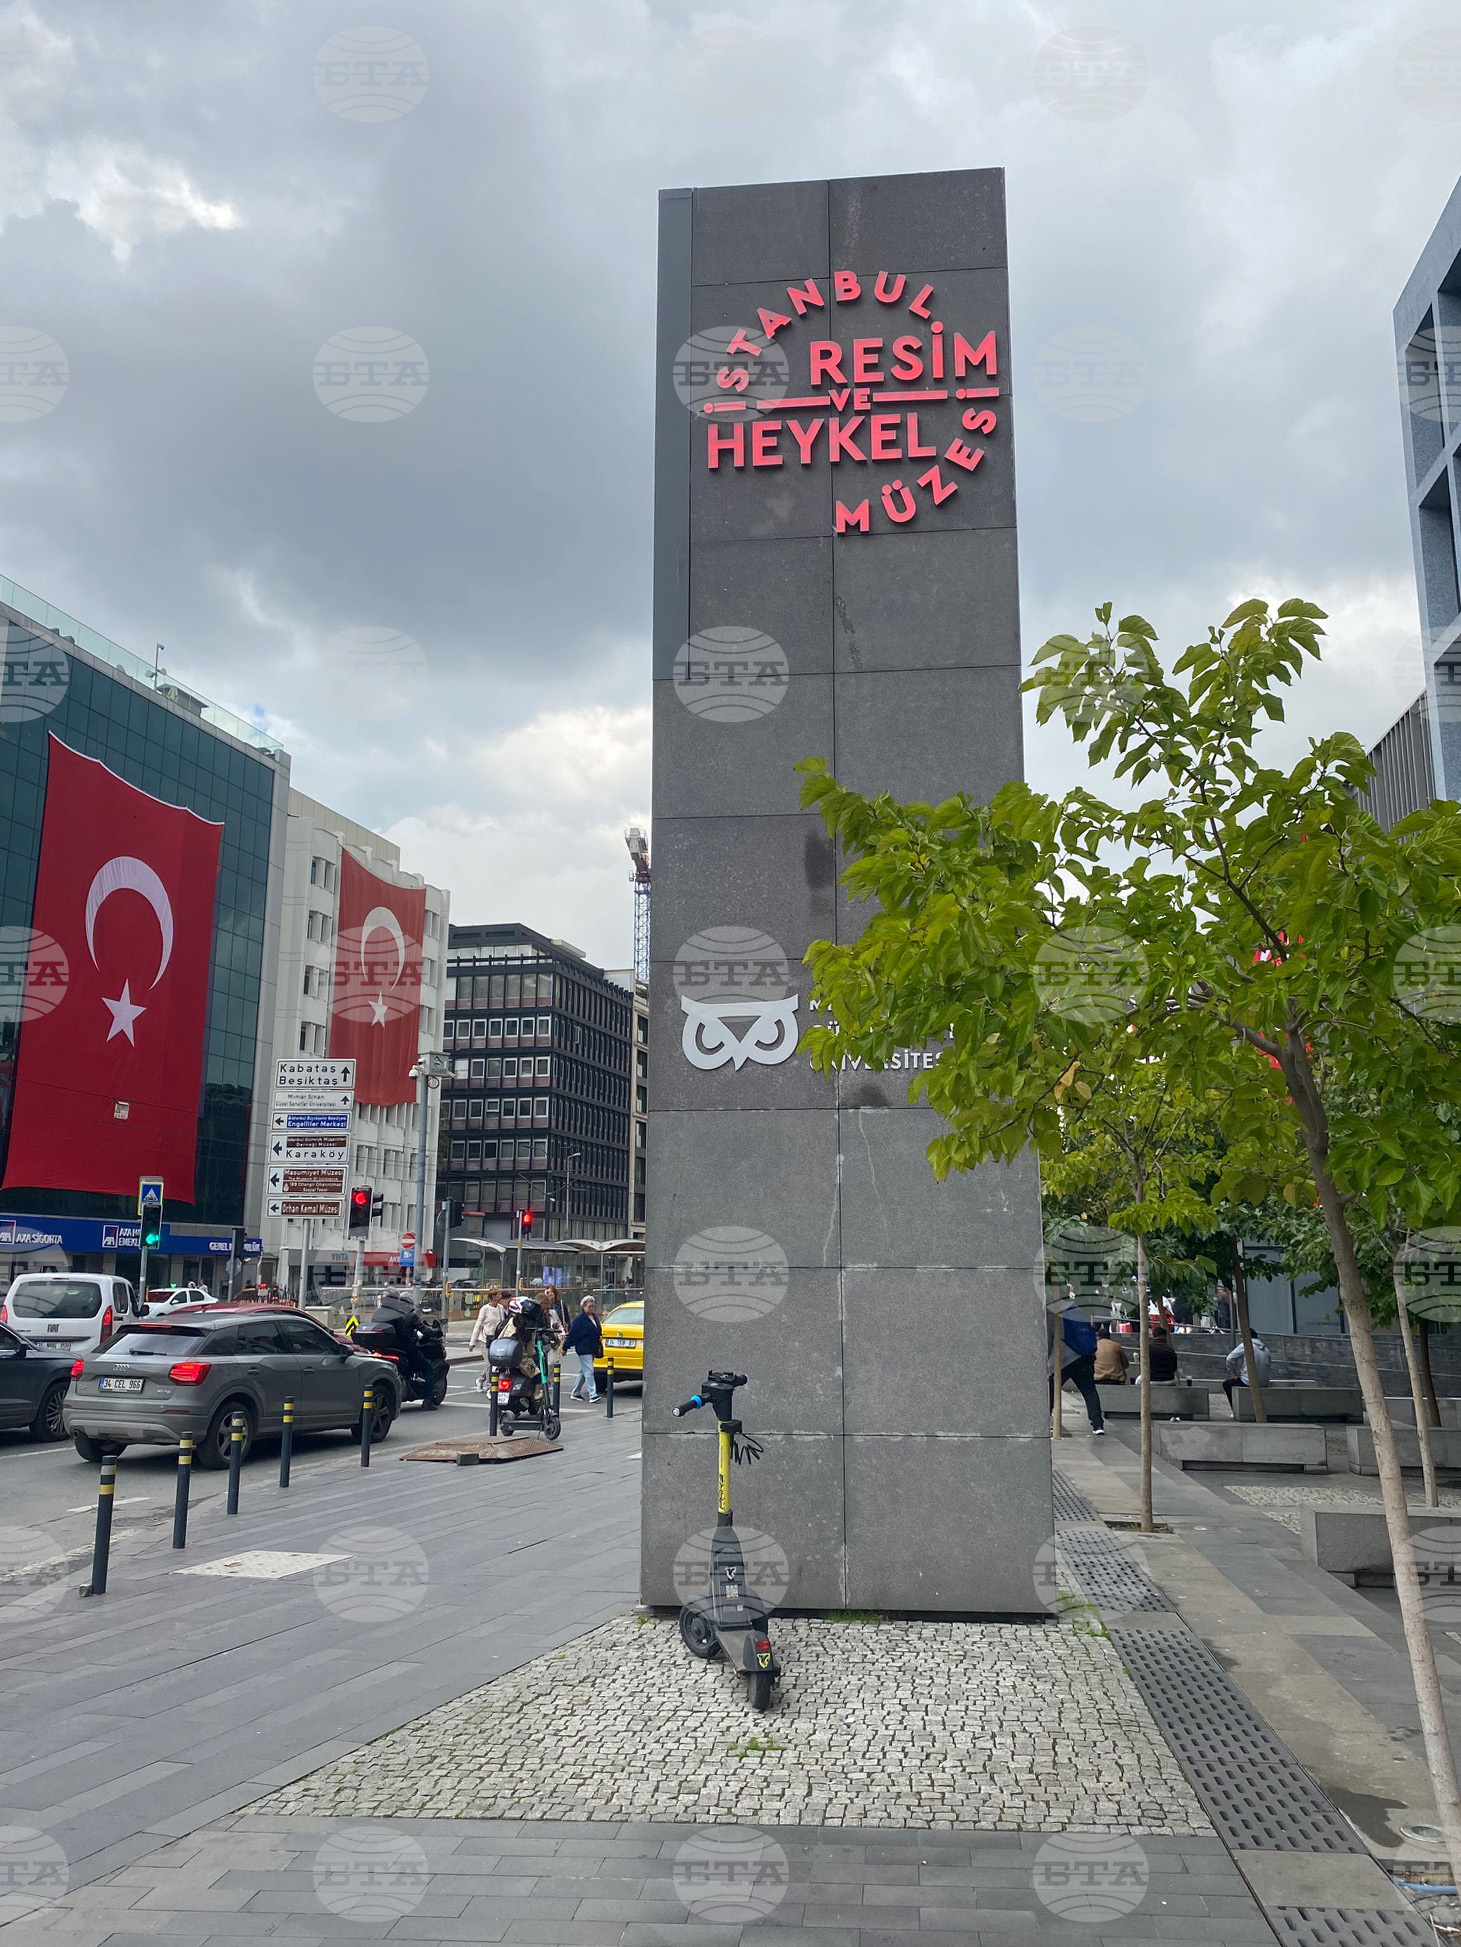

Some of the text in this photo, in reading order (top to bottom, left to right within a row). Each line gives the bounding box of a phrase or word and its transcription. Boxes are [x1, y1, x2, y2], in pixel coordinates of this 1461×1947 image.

[703, 270, 934, 414] İSTANBUL
[810, 320, 998, 387] RESİM
[828, 387, 872, 412] VE
[707, 411, 938, 471] HEYKEL
[835, 386, 1000, 535] MÜZESİ
[280, 1063, 336, 1073] Kabataş
[279, 1076, 338, 1086] Beşiktaş
[286, 1149, 345, 1160] Karaköy
[16, 1233, 63, 1244] AXA SİGORTA
